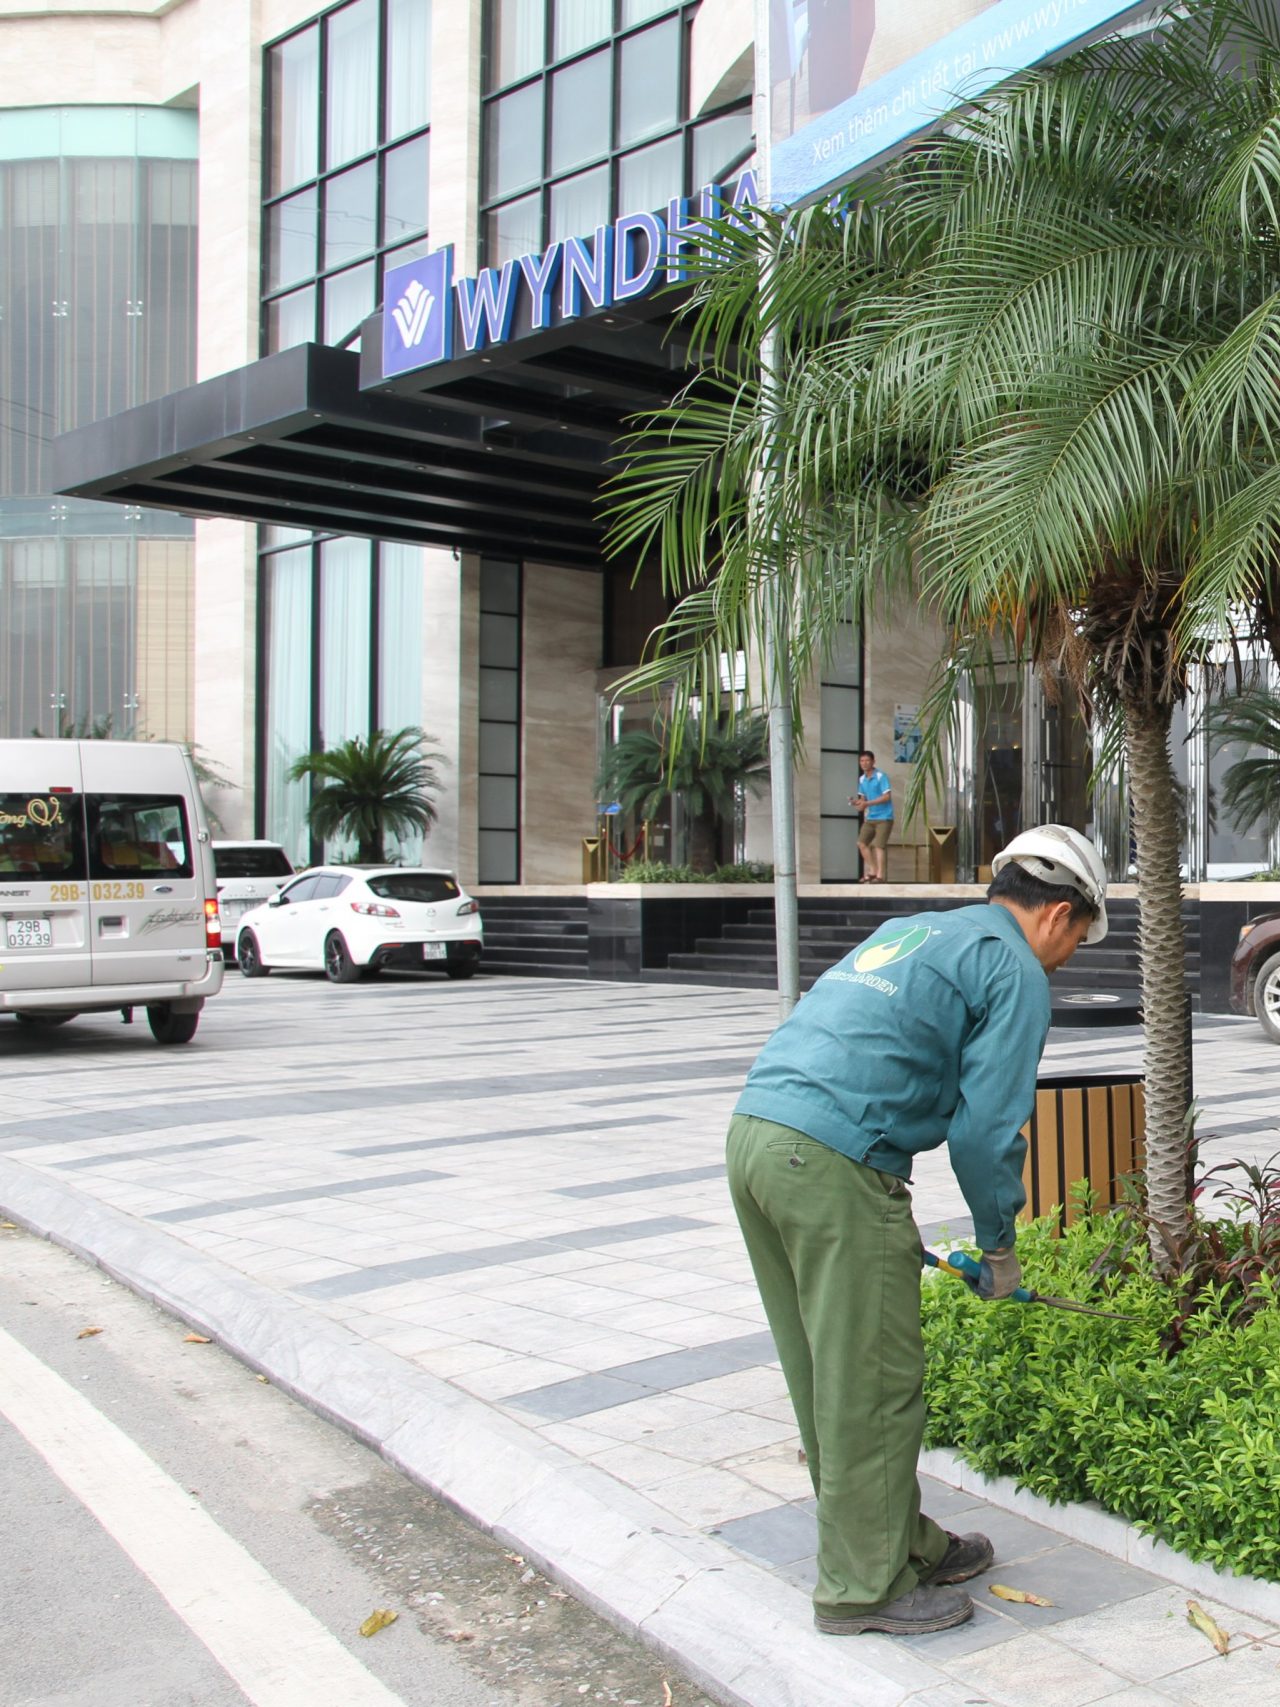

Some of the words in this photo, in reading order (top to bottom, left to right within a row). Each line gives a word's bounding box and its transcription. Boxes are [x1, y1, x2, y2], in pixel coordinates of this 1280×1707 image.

[812, 131, 845, 166] Xem
[848, 104, 888, 143] thêm
[892, 82, 916, 117] chi
[920, 60, 950, 100] tiết
[456, 168, 848, 352] WYNDHA
[93, 882, 145, 900] 032.39
[17, 921, 41, 933] 29B
[9, 933, 51, 946] 032.39
